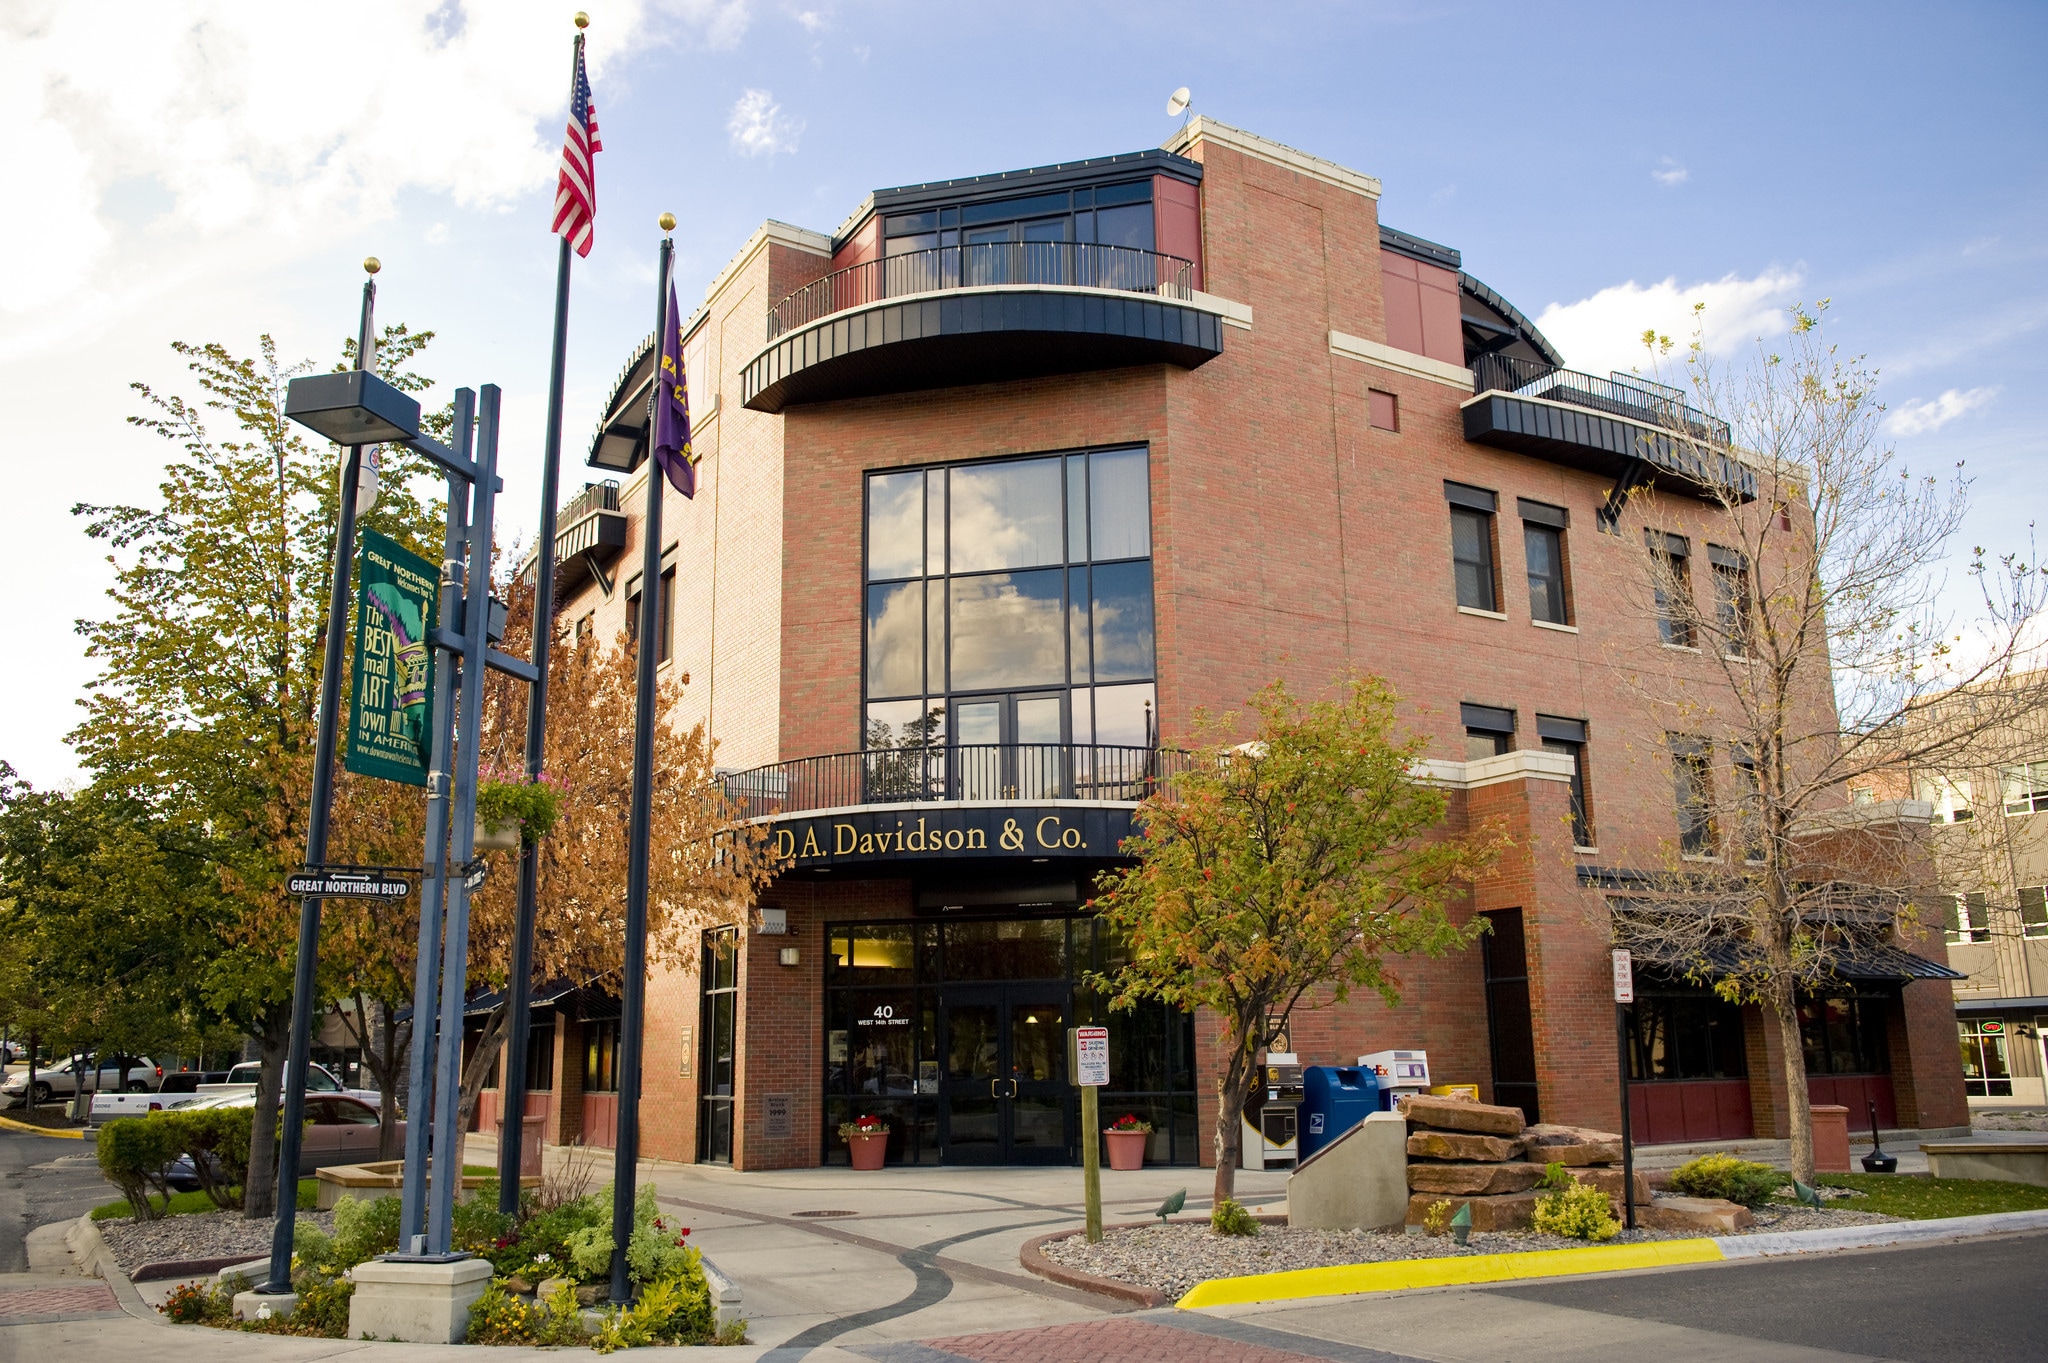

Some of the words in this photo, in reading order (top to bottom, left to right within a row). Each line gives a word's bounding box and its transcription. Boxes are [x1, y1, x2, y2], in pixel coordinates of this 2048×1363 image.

[368, 551, 392, 570] GREAT
[393, 563, 435, 592] NORTHERN
[397, 576, 420, 594] Welcomes
[366, 605, 384, 628] The
[364, 625, 393, 658] BEST
[363, 652, 389, 677] Small
[360, 673, 390, 709] ART
[360, 703, 387, 733] Town
[358, 730, 370, 741] IN
[373, 734, 419, 756] AMERICA
[776, 825, 827, 859] D.A.
[834, 818, 987, 855] Davidson
[1000, 818, 1024, 852] &
[1036, 816, 1087, 850] Co.
[291, 879, 324, 892] GREAT
[325, 881, 379, 894] NORTHERN
[381, 883, 407, 895] BLVD
[874, 1005, 893, 1018] 40
